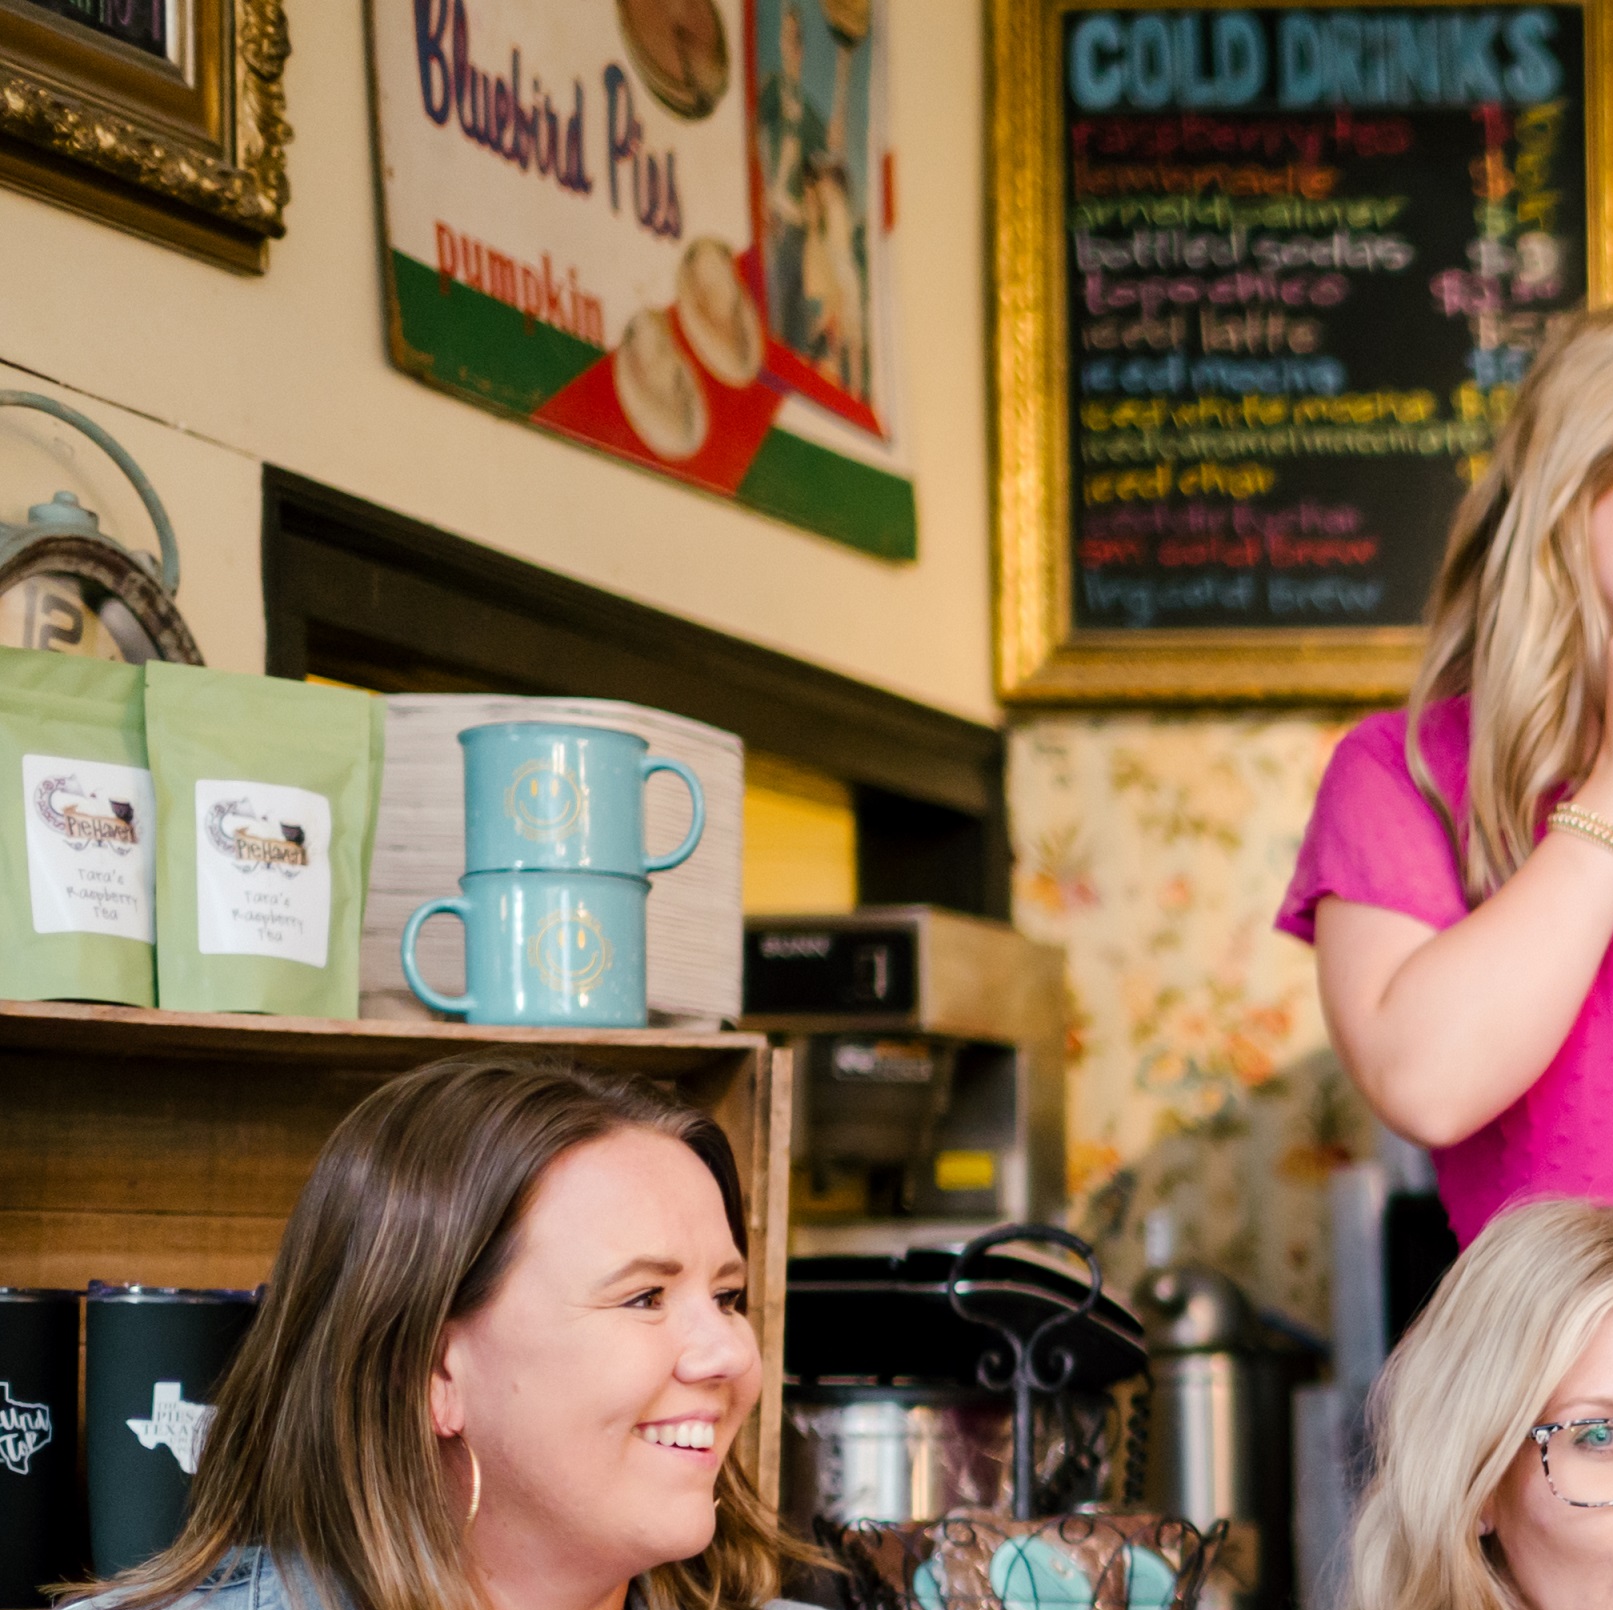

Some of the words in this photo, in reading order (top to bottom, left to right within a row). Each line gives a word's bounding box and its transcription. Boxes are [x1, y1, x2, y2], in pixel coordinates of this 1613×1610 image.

[1070, 13, 1267, 108] COLD
[1280, 8, 1562, 107] DRINKS
[414, 0, 593, 196] Bluebird
[603, 62, 683, 241] Pies
[434, 218, 606, 346] pumpkin
[93, 906, 119, 921] Tea
